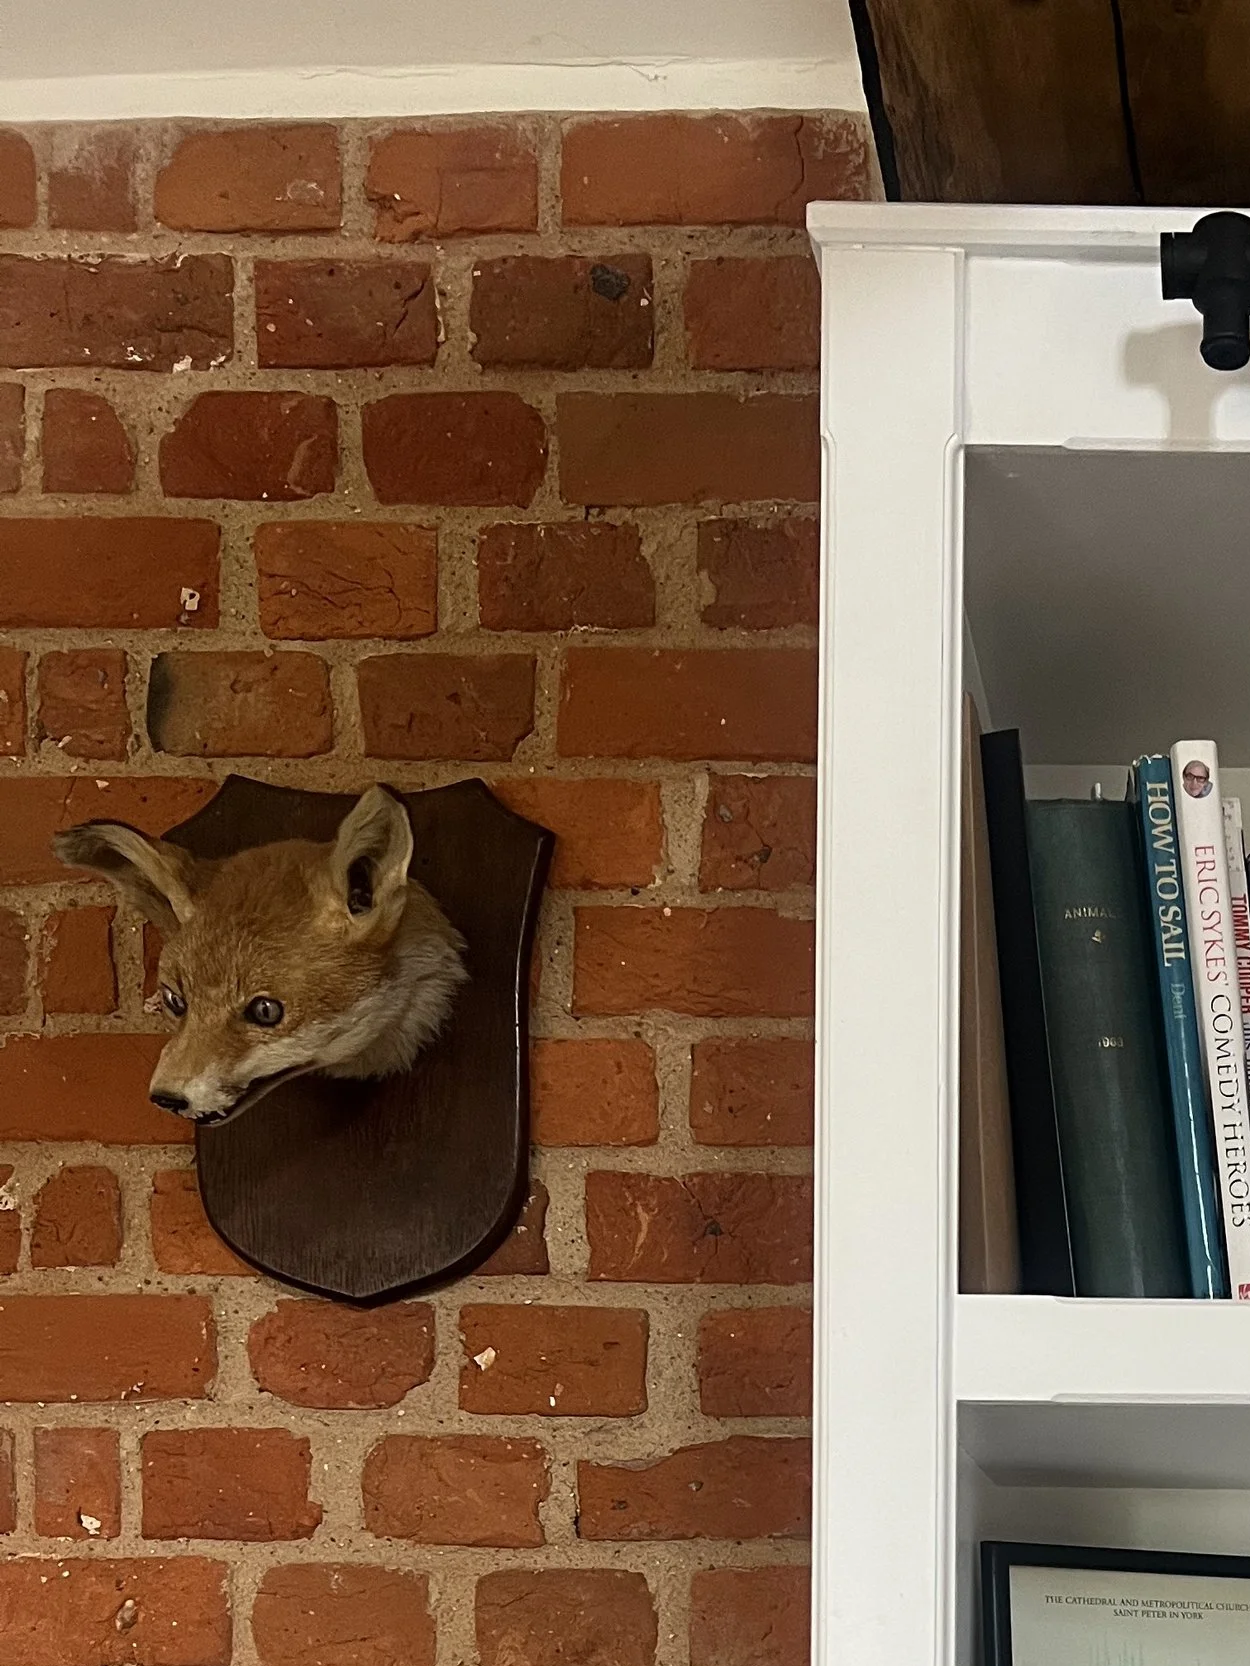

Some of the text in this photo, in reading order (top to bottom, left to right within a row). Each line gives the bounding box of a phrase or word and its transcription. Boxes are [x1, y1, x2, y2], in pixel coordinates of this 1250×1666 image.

[1146, 781, 1186, 967] HOW TO SAIL
[1194, 845, 1220, 904] ERIC
[1201, 909, 1229, 986] SYKES'
[1171, 983, 1186, 1019] Dent
[1211, 994, 1241, 1114] COMEDY
[1045, 1595, 1063, 1604] THE
[1065, 1596, 1117, 1606] CATHEDRAL
[1119, 1599, 1139, 1607] AND
[1141, 1600, 1214, 1610] METROPOLITICAL
[1113, 1609, 1139, 1617] SAINT
[1141, 1610, 1167, 1618] PETER
[1181, 1612, 1204, 1620] YORK
